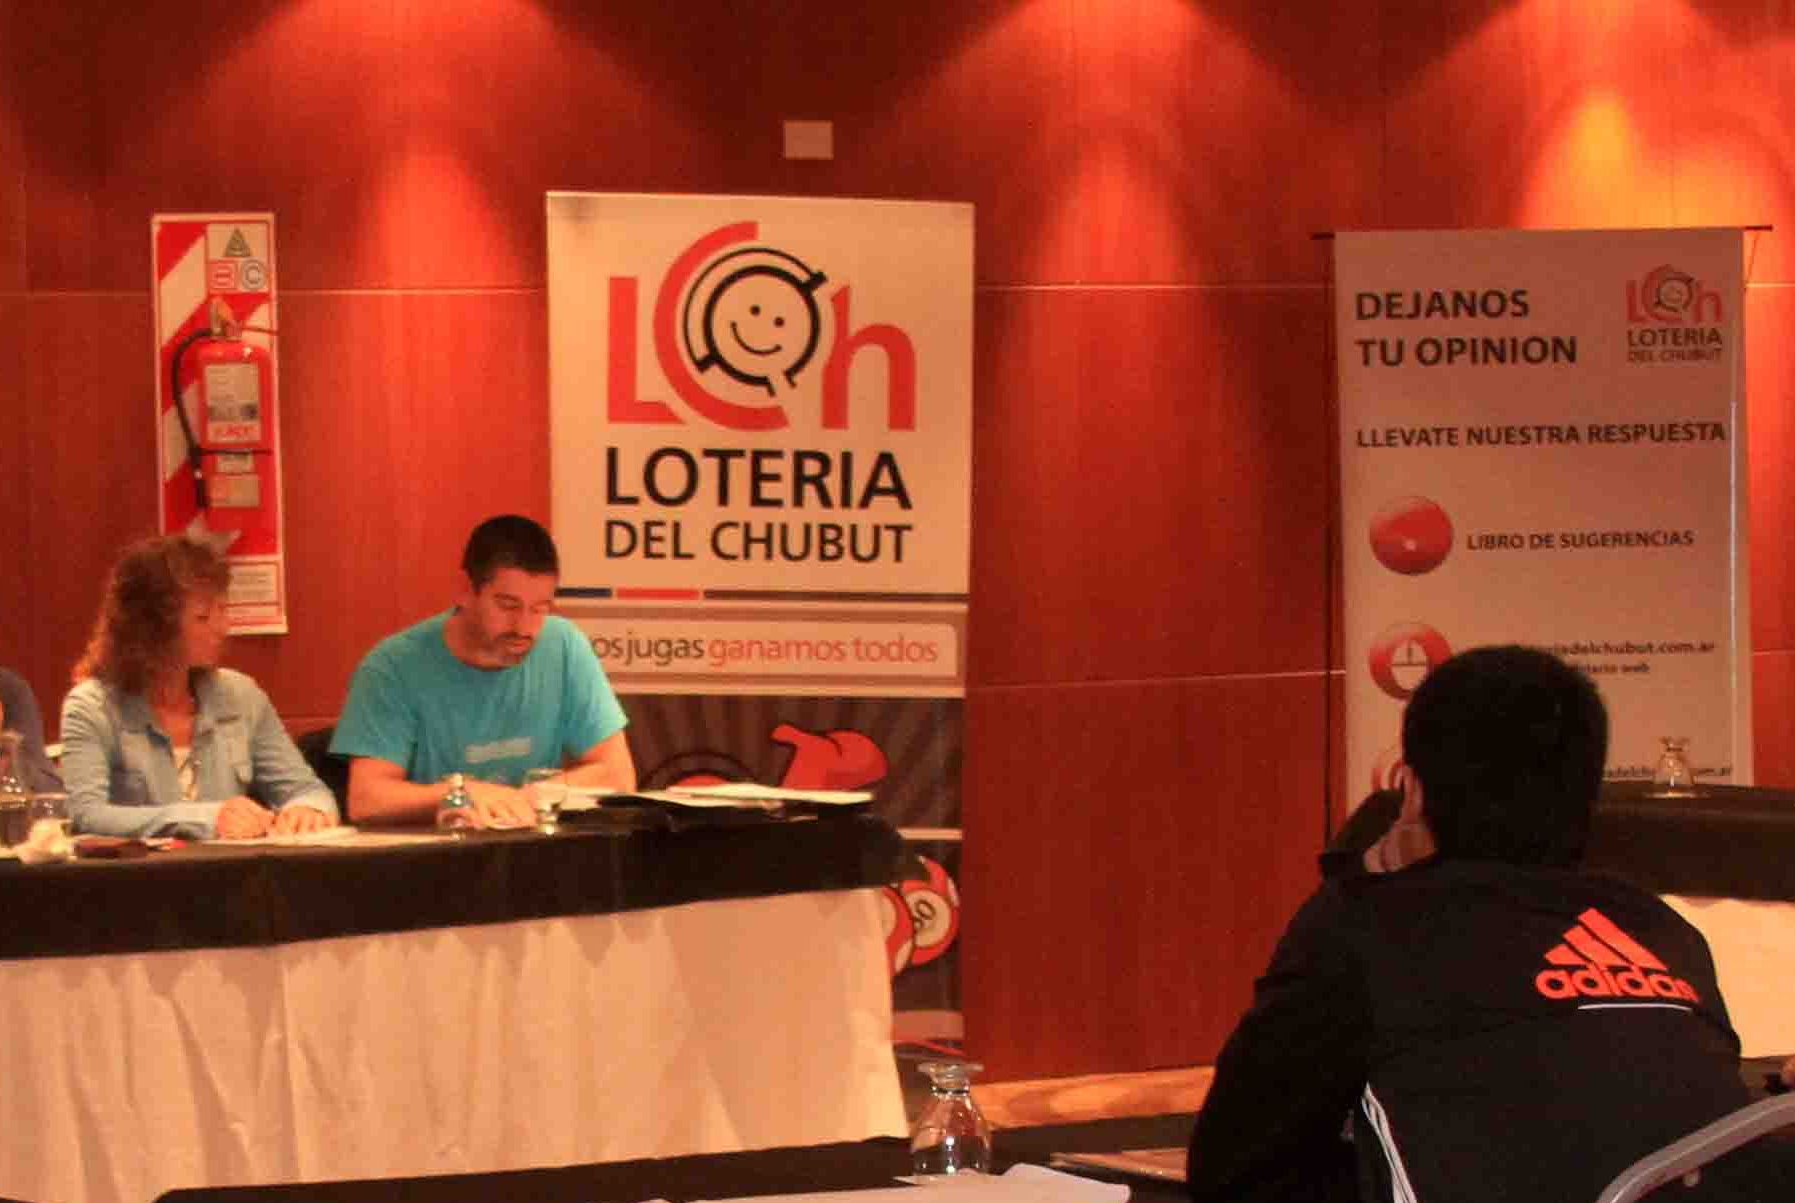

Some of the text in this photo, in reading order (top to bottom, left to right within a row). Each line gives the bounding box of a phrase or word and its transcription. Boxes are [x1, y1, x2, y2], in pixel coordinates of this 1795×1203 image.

[1355, 289, 1530, 321] DEJANOS
[1356, 336, 1578, 367] TU OPINION
[1626, 327, 1723, 346] LOTERIA
[1356, 422, 1726, 448] LLEVATE NUESTRA RESPUESTA
[606, 446, 913, 510] LOTERIA
[604, 519, 913, 563] DEL CHUBUT
[1467, 530, 1694, 551] LIBRO DE SUGERENCIAS
[852, 633, 938, 663] todos
[1535, 966, 1699, 1003] adidas
